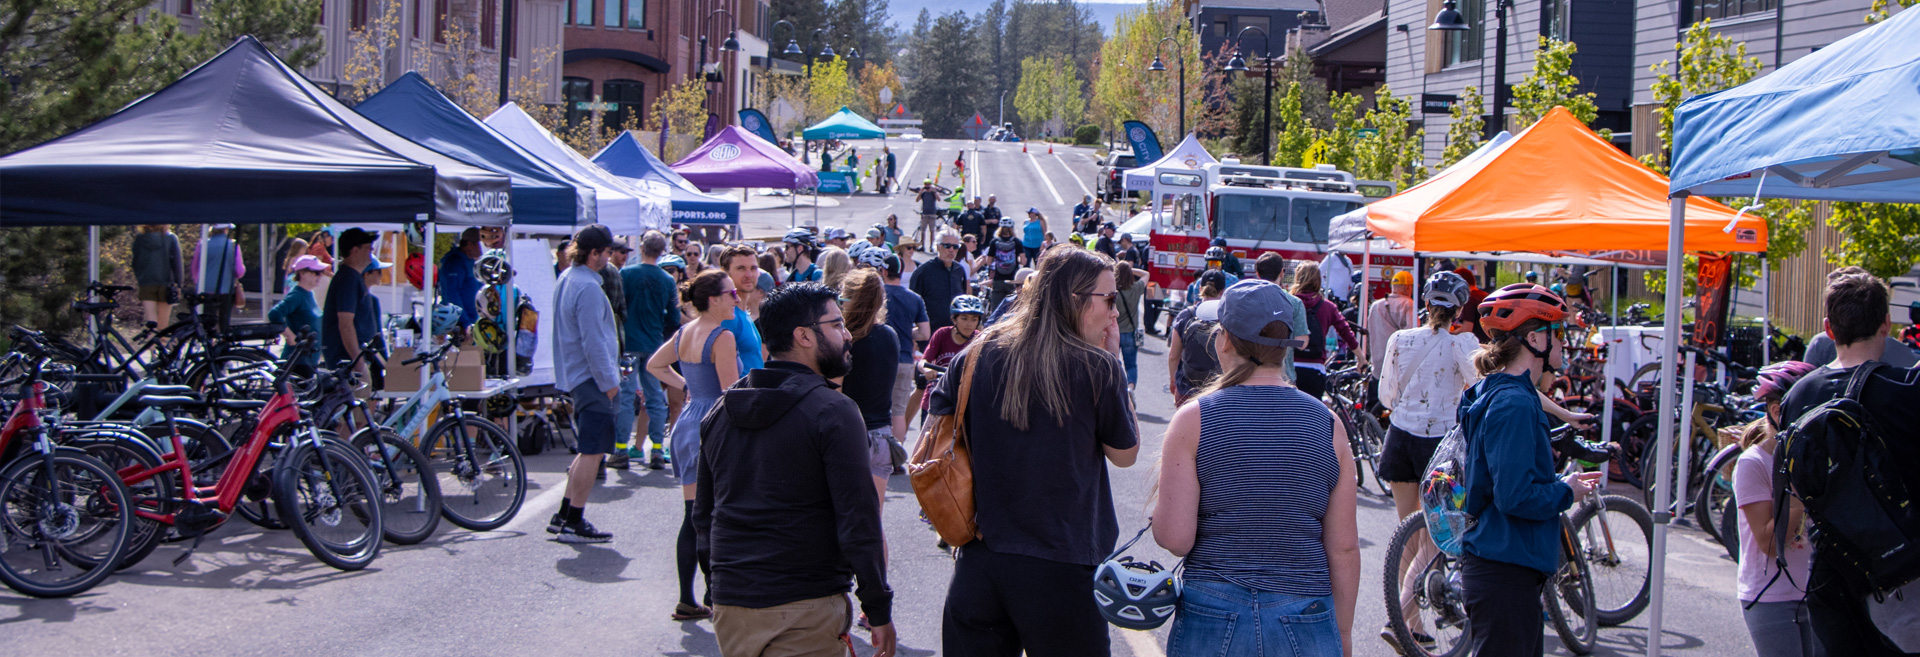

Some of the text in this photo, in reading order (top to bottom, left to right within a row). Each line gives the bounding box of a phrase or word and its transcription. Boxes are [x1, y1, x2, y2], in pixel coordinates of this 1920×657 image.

[1139, 142, 1151, 160] CITY
[1168, 243, 1199, 252] BEND
[1373, 256, 1405, 265] BEND
[1537, 310, 1554, 319] SMITH
